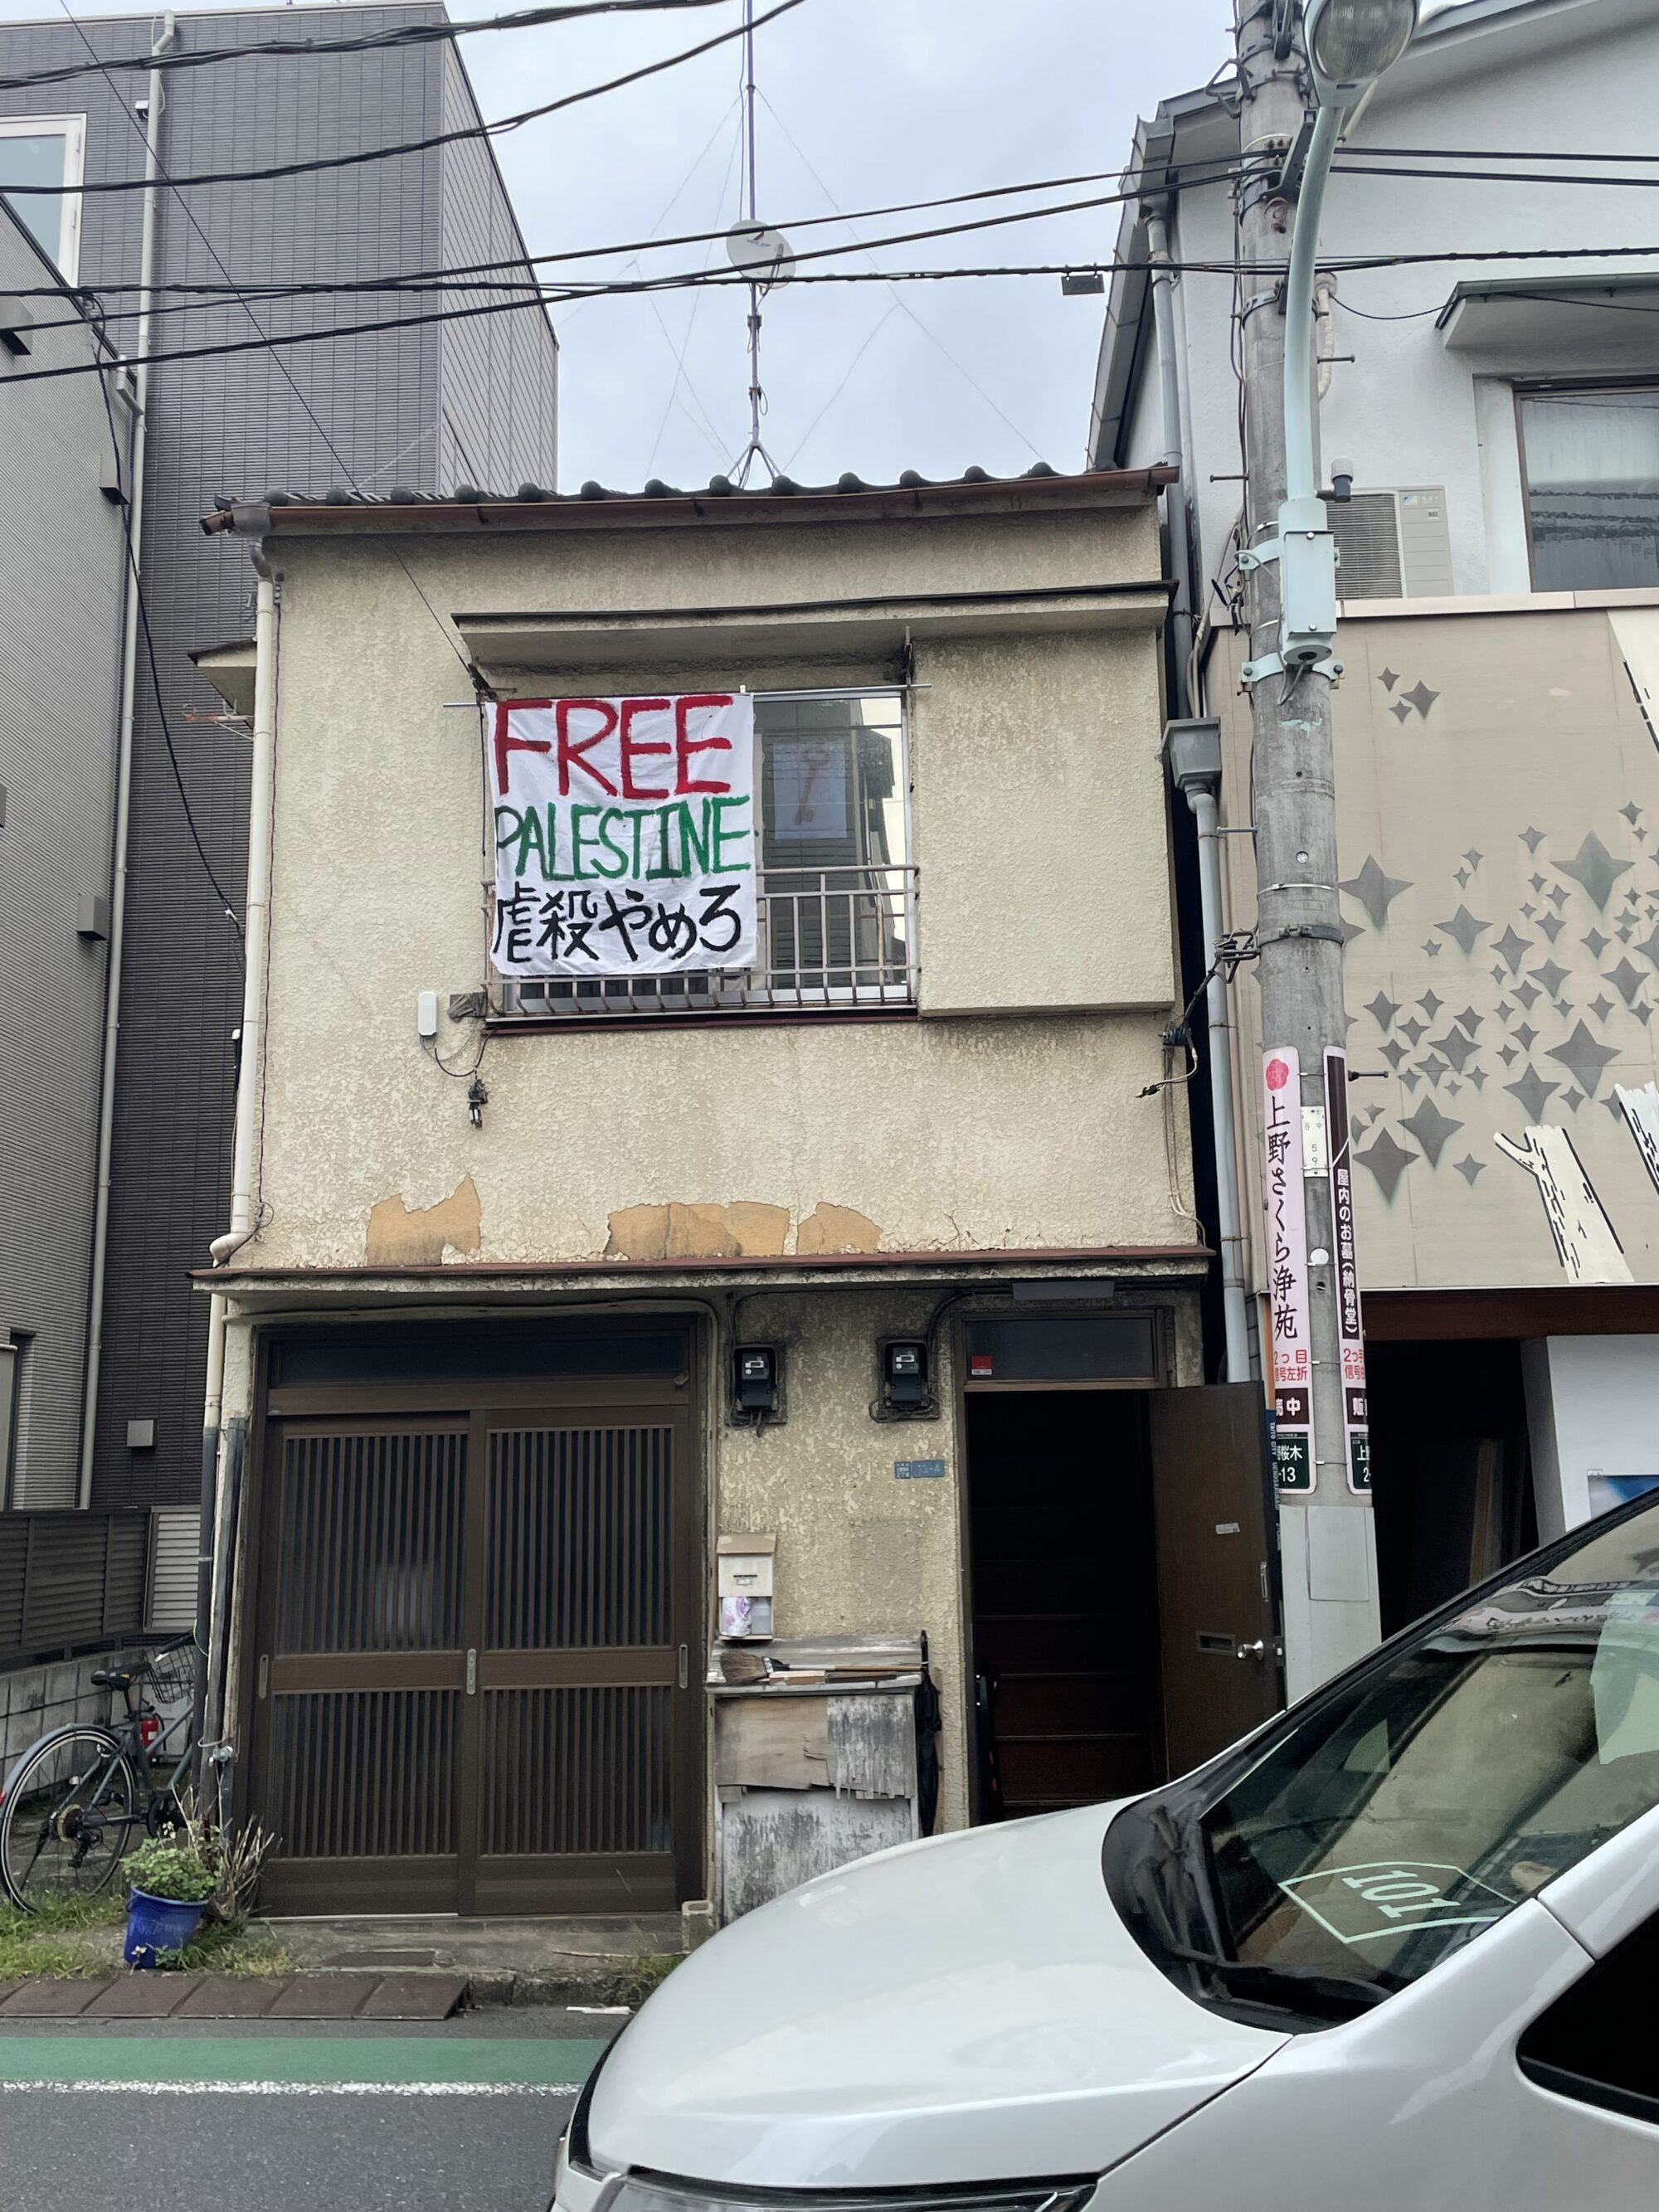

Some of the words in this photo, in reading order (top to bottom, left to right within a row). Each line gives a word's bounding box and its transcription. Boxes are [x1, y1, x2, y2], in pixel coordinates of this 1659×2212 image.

[494, 695, 733, 800] FREE
[494, 795, 751, 881] PALESTINE
[493, 881, 742, 963] 虐殺やめろ
